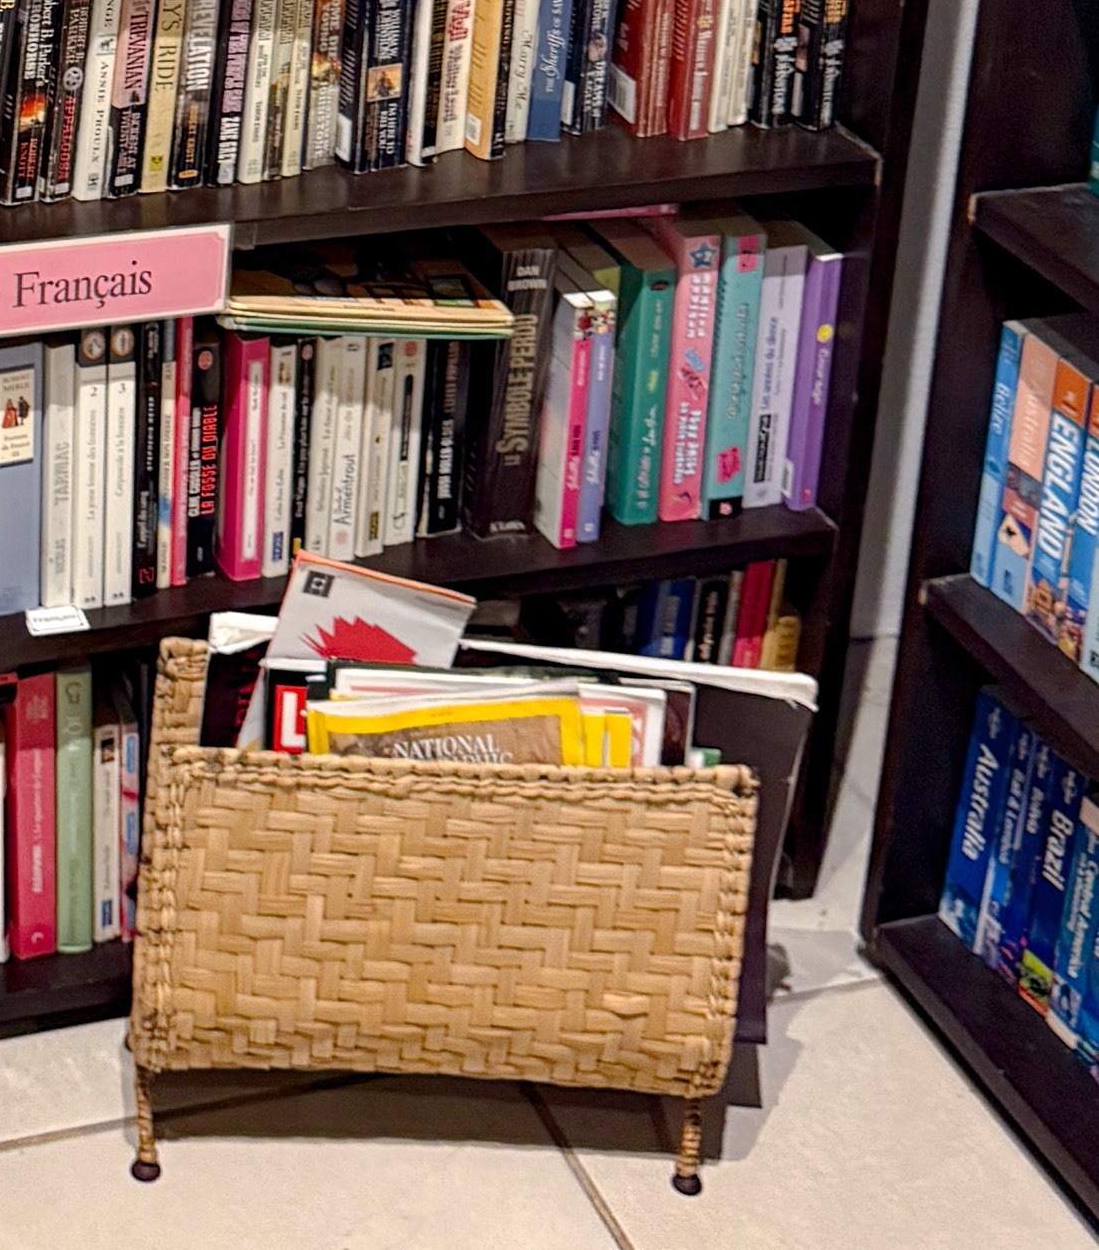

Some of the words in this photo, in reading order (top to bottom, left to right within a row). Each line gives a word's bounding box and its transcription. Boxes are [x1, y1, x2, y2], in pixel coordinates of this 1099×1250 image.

[123, 9, 149, 90] TREVANIAN
[155, 44, 177, 92] RIDE
[13, 260, 153, 308] Français
[1037, 411, 1080, 561] ENGLAND
[393, 734, 500, 760] NATIONAL
[962, 743, 1000, 862] Australia
[1042, 809, 1074, 892] Brazil
